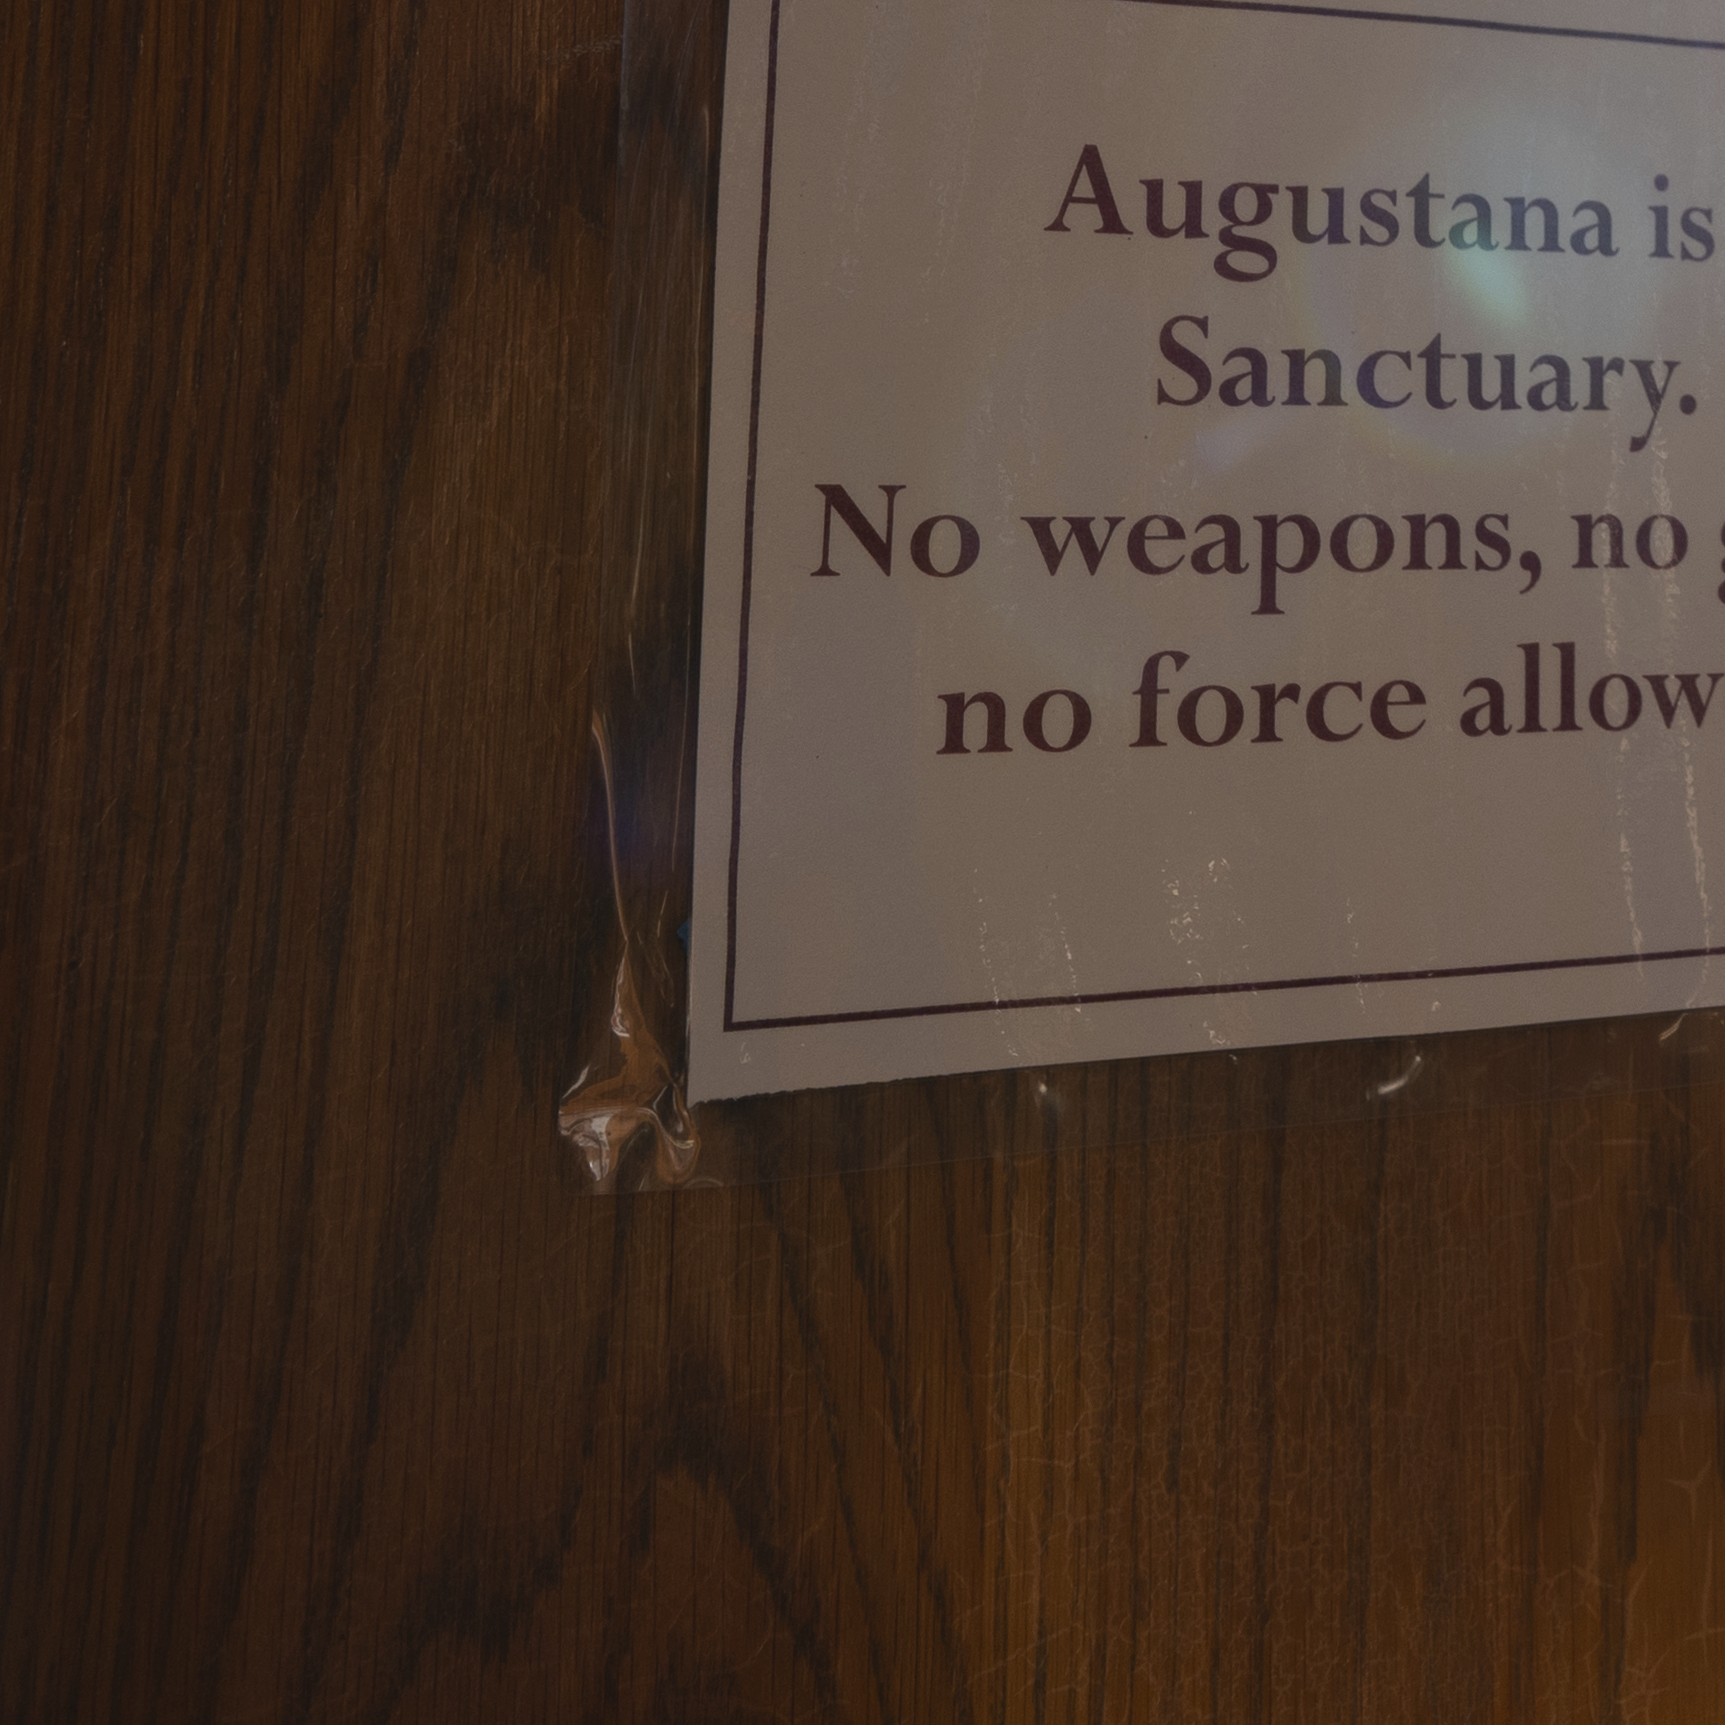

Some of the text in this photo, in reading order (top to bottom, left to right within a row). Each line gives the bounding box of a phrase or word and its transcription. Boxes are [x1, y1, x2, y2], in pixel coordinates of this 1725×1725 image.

[1045, 144, 1617, 283] Augustana
[1650, 175, 1714, 261] is
[1157, 315, 1697, 453] Sanctuary.
[811, 484, 980, 578] No
[1021, 514, 1542, 615] weapons,
[1571, 514, 1688, 570] no
[937, 689, 1092, 755] no
[1130, 651, 1426, 747] force
